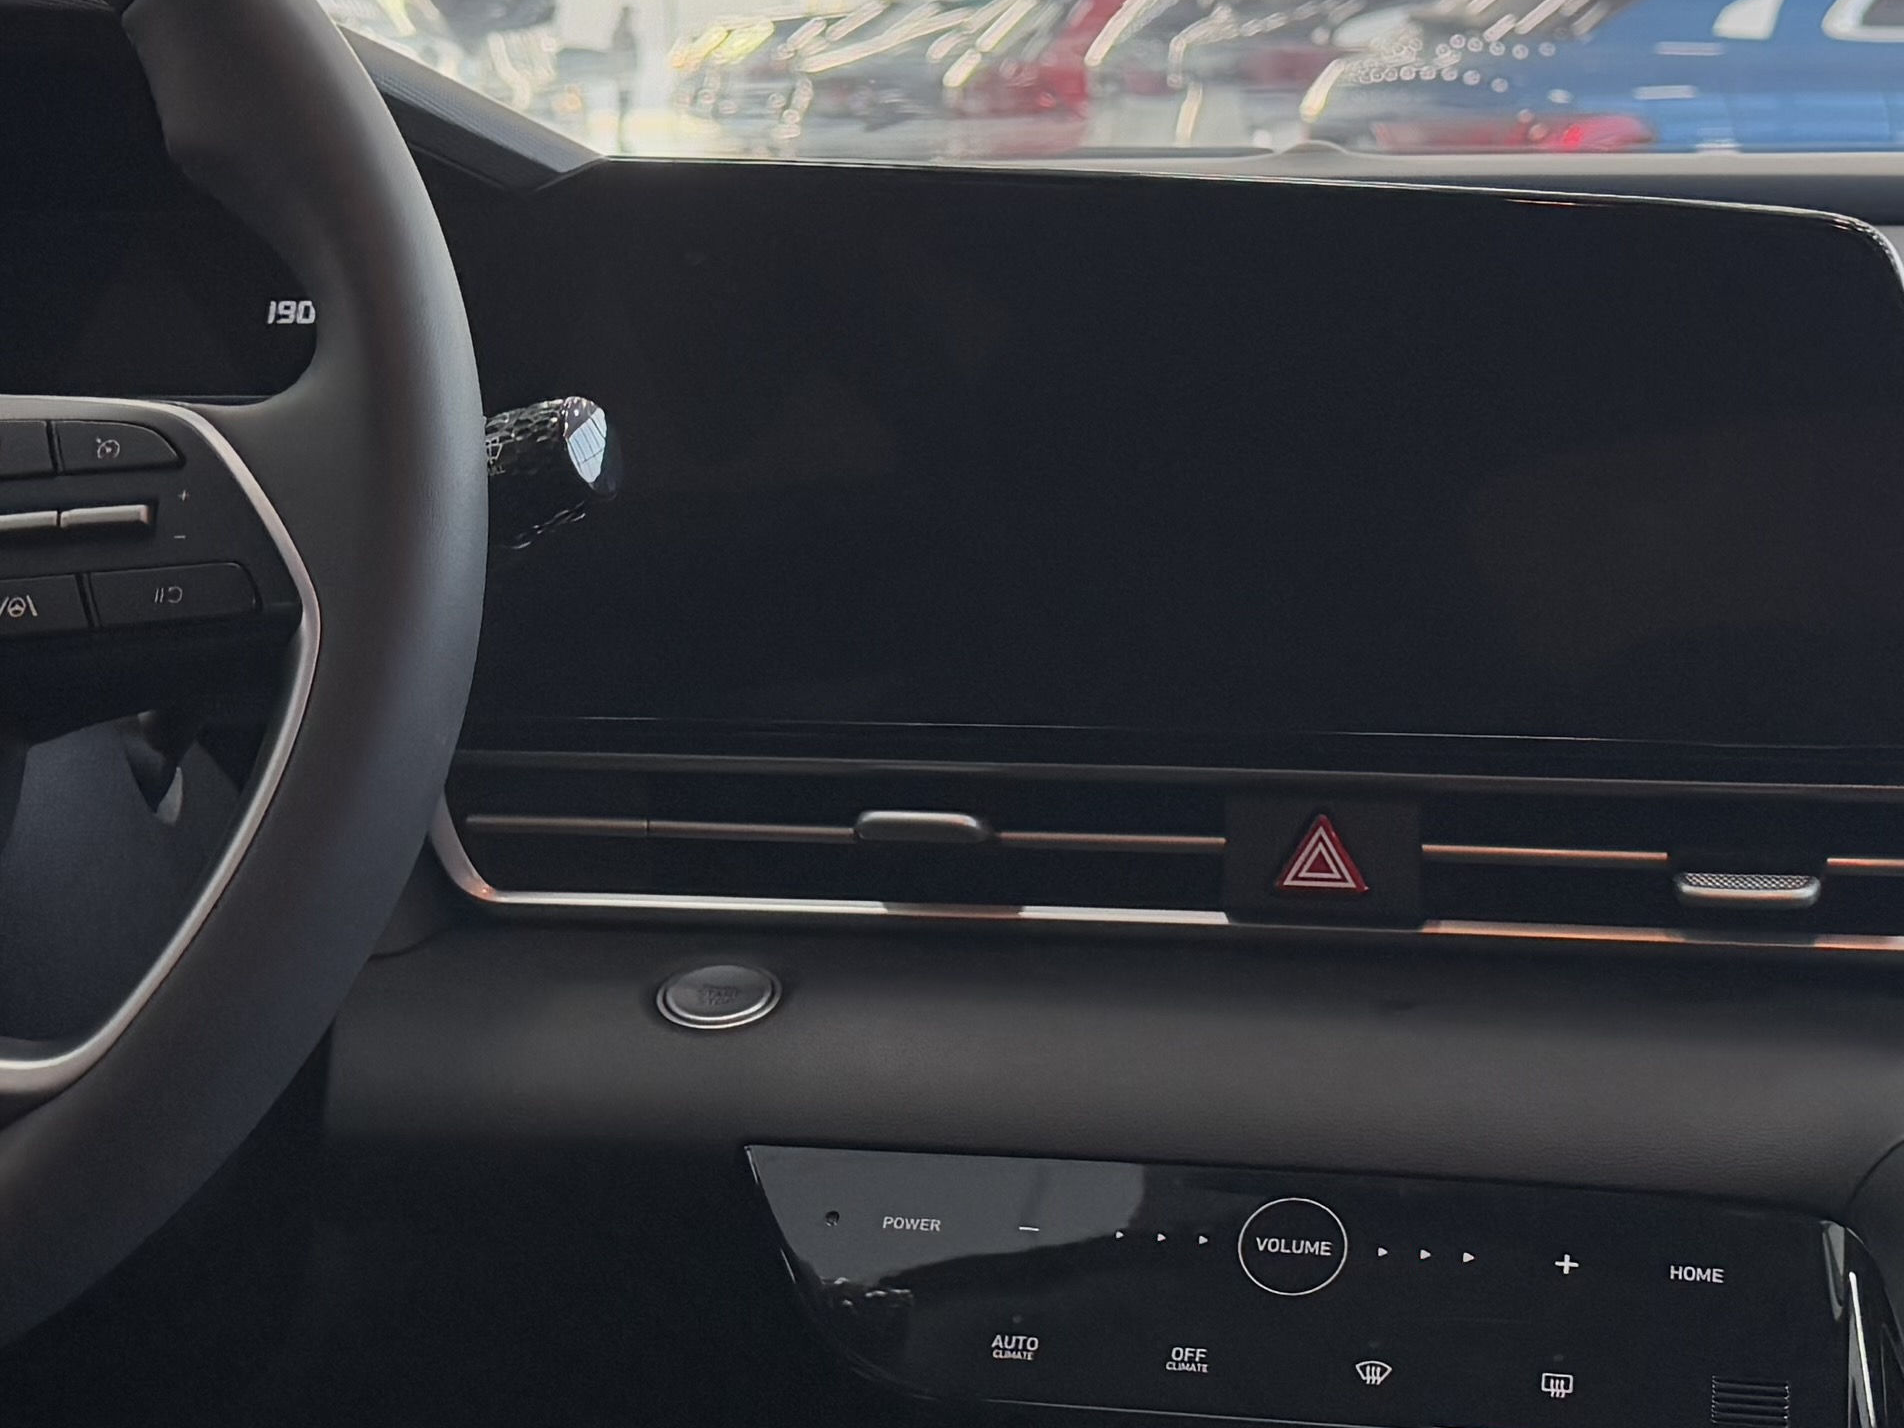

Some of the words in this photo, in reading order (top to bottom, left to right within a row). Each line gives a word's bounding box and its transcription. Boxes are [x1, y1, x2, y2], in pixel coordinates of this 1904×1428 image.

[267, 299, 316, 325] 190
[881, 1215, 942, 1232] POWER
[1255, 1235, 1333, 1258] VOLUME
[1669, 1264, 1726, 1284] HOME
[991, 1333, 1040, 1351] AUTO
[992, 1348, 1035, 1361] CLIMATE
[1171, 1346, 1209, 1362] OFF
[1165, 1361, 1210, 1373] CLIMATE
